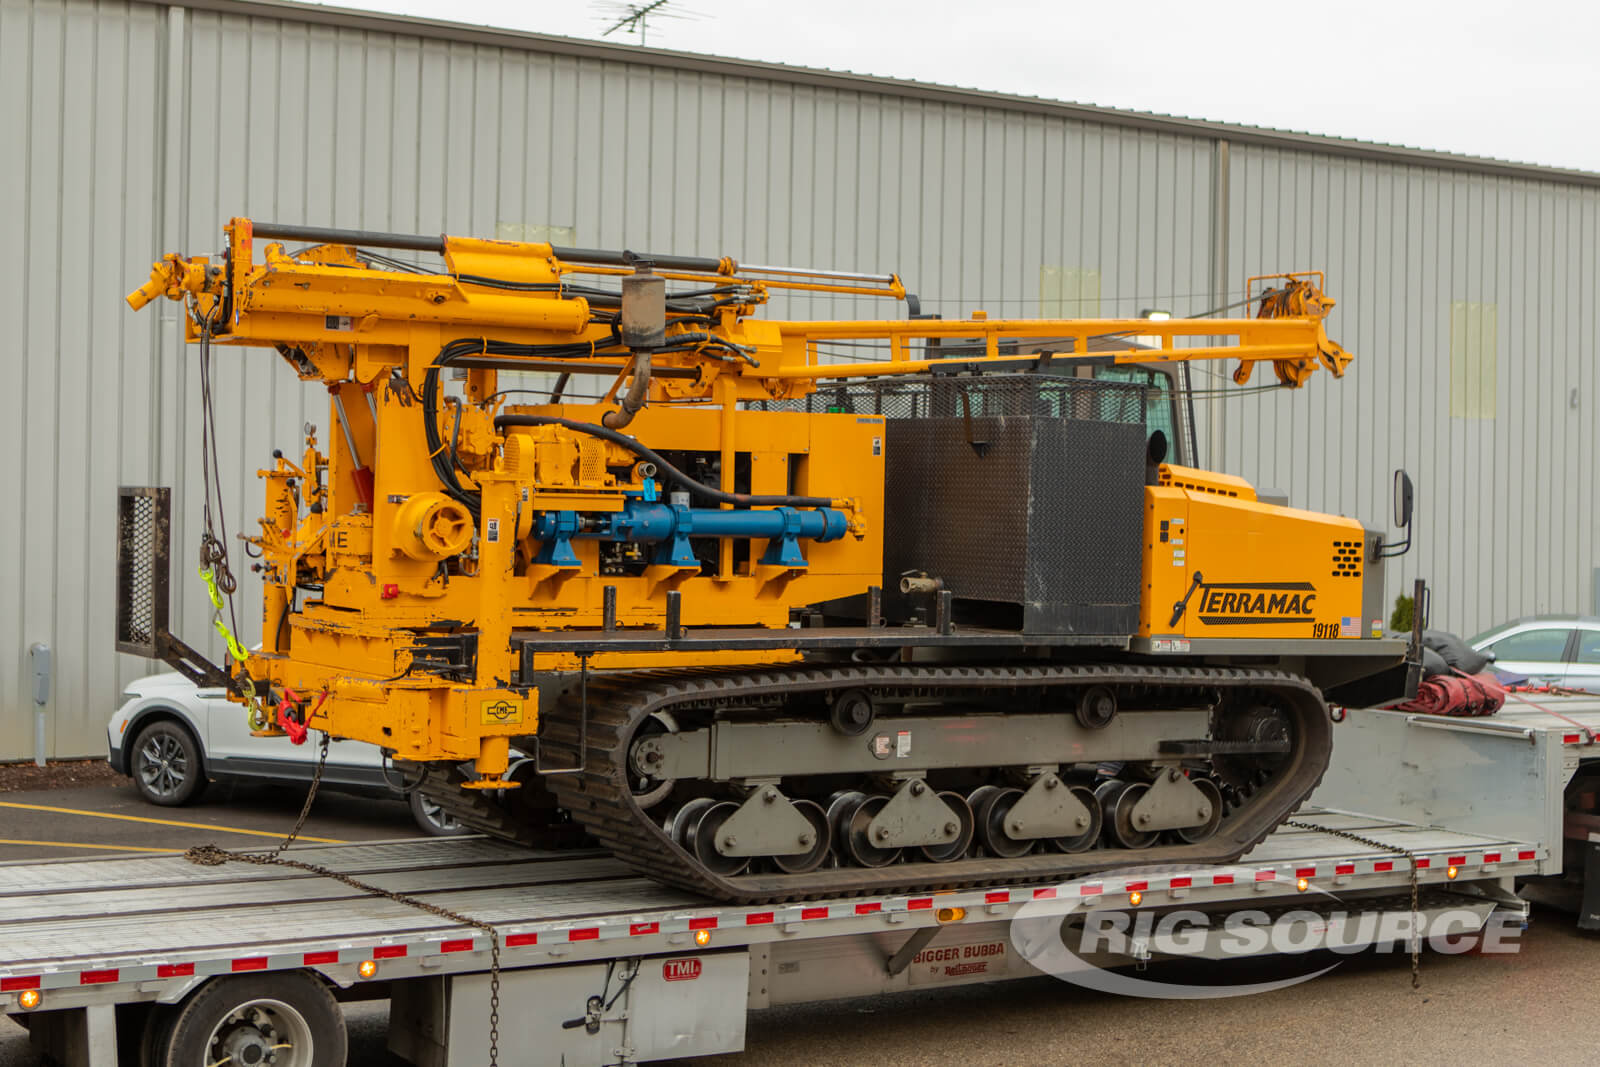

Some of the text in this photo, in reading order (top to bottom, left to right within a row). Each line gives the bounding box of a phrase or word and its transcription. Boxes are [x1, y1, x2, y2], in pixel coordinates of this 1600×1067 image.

[1199, 584, 1316, 614] TERRAMAC
[1313, 623, 1339, 639] 19118
[963, 942, 1004, 959] BUBBA
